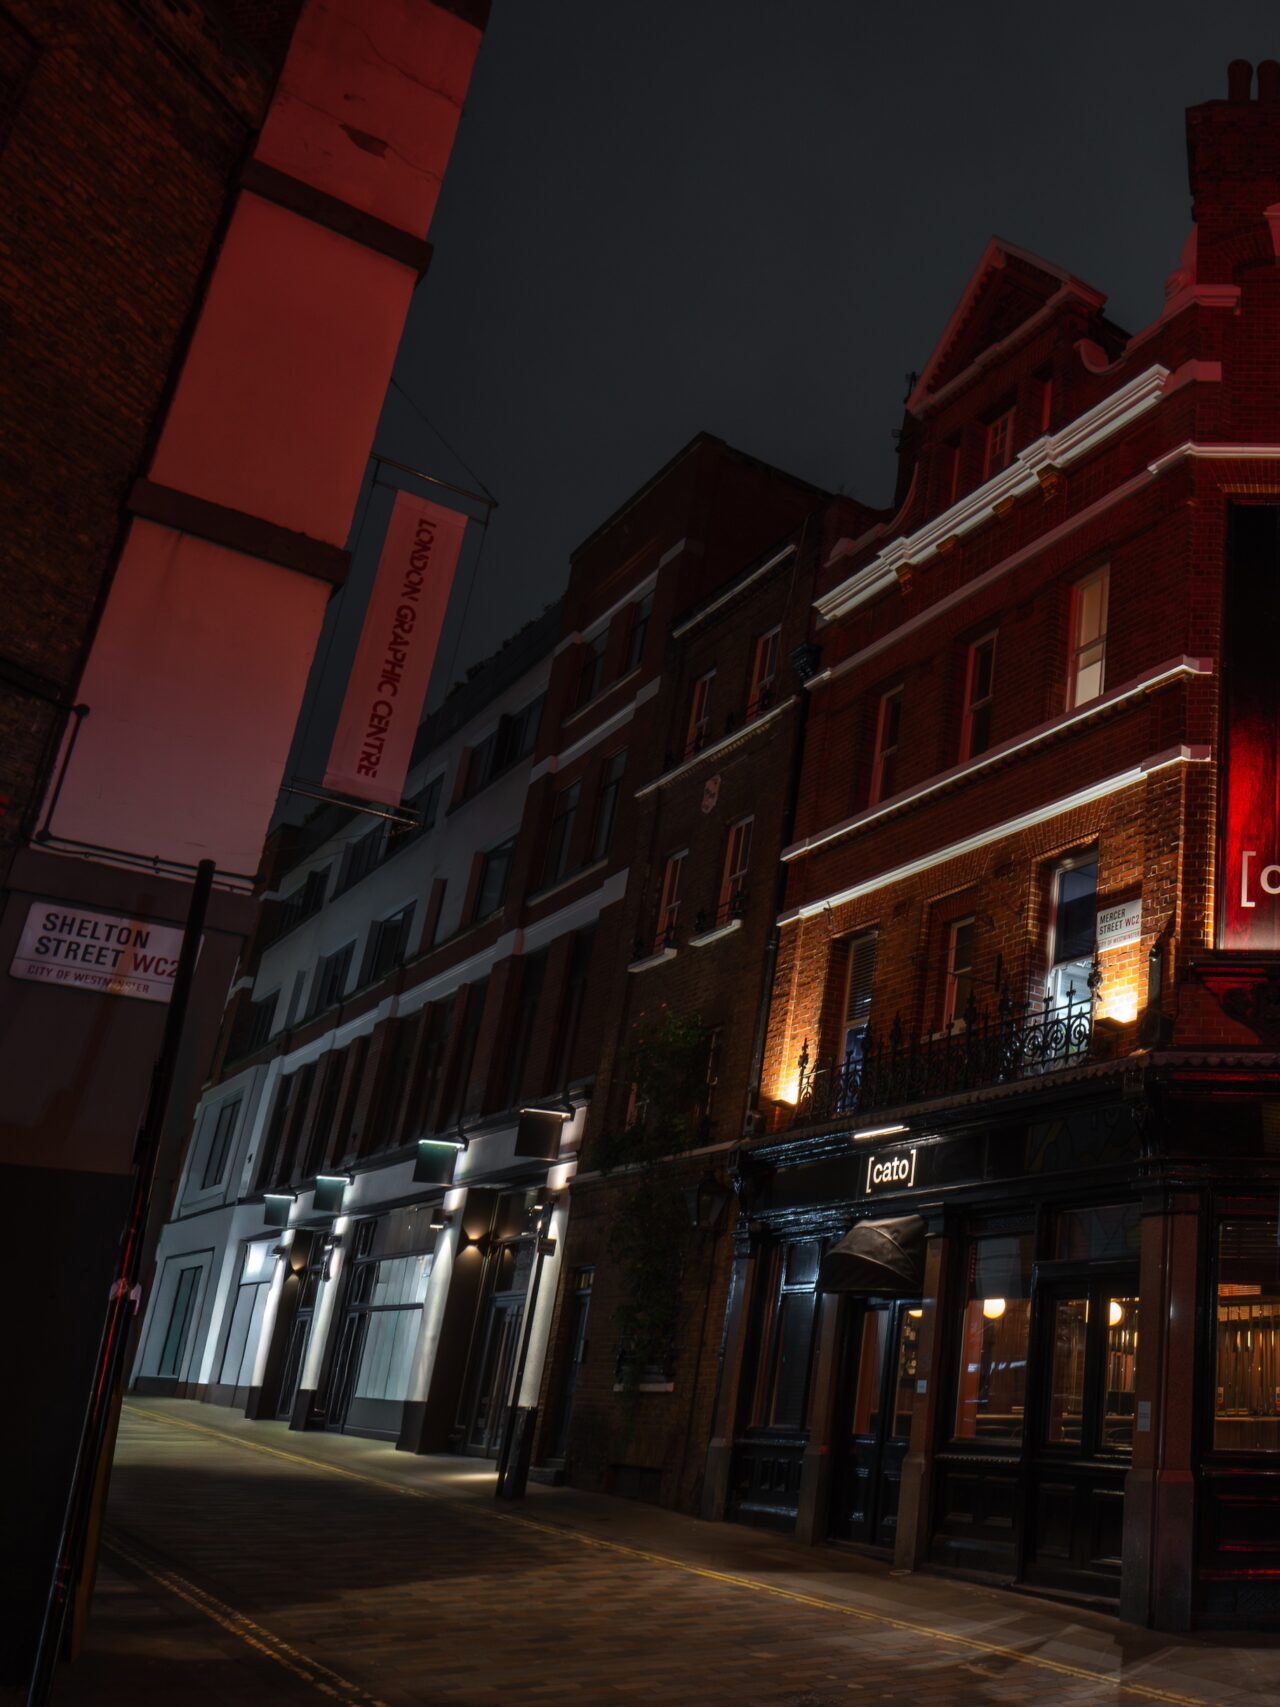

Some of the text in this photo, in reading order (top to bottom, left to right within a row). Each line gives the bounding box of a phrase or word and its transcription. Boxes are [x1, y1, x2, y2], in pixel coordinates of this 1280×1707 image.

[356, 518, 437, 778] LONDON GRAPHIC CENTRE
[42, 913, 150, 949] SHELTON
[1099, 914, 1140, 935] STREET WC2
[1100, 908, 1126, 924] MERCER
[27, 964, 53, 977] CITY
[56, 968, 71, 980] OF
[35, 936, 181, 978] STREET WC2
[866, 1149, 917, 1193] [cato]
